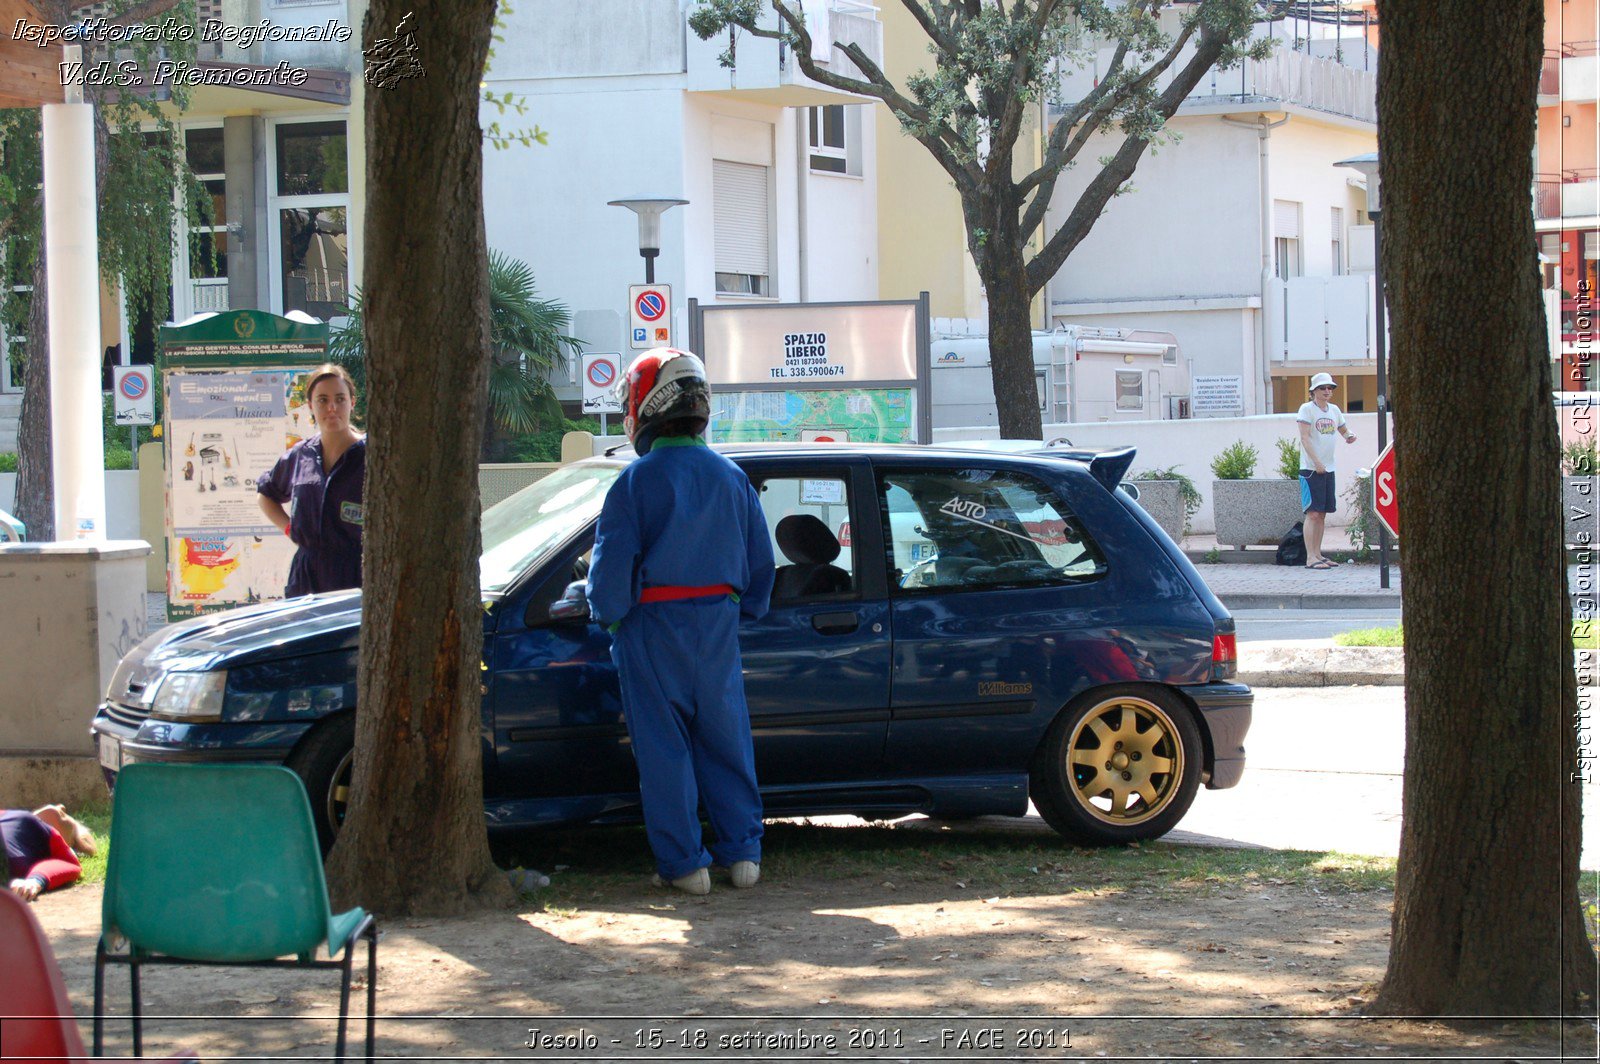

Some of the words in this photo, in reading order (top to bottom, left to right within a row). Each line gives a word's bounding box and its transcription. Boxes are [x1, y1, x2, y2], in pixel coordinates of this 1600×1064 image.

[784, 333, 826, 346] SPAZIO
[786, 346, 825, 358] LIBERO
[785, 358, 800, 366] 0421
[770, 368, 787, 377] TEL.
[790, 366, 844, 377] 338.5900674
[648, 380, 681, 409] YAMAHA
[233, 406, 273, 418] Musica
[942, 496, 986, 519] AUTO
[978, 681, 1032, 696] Williams
